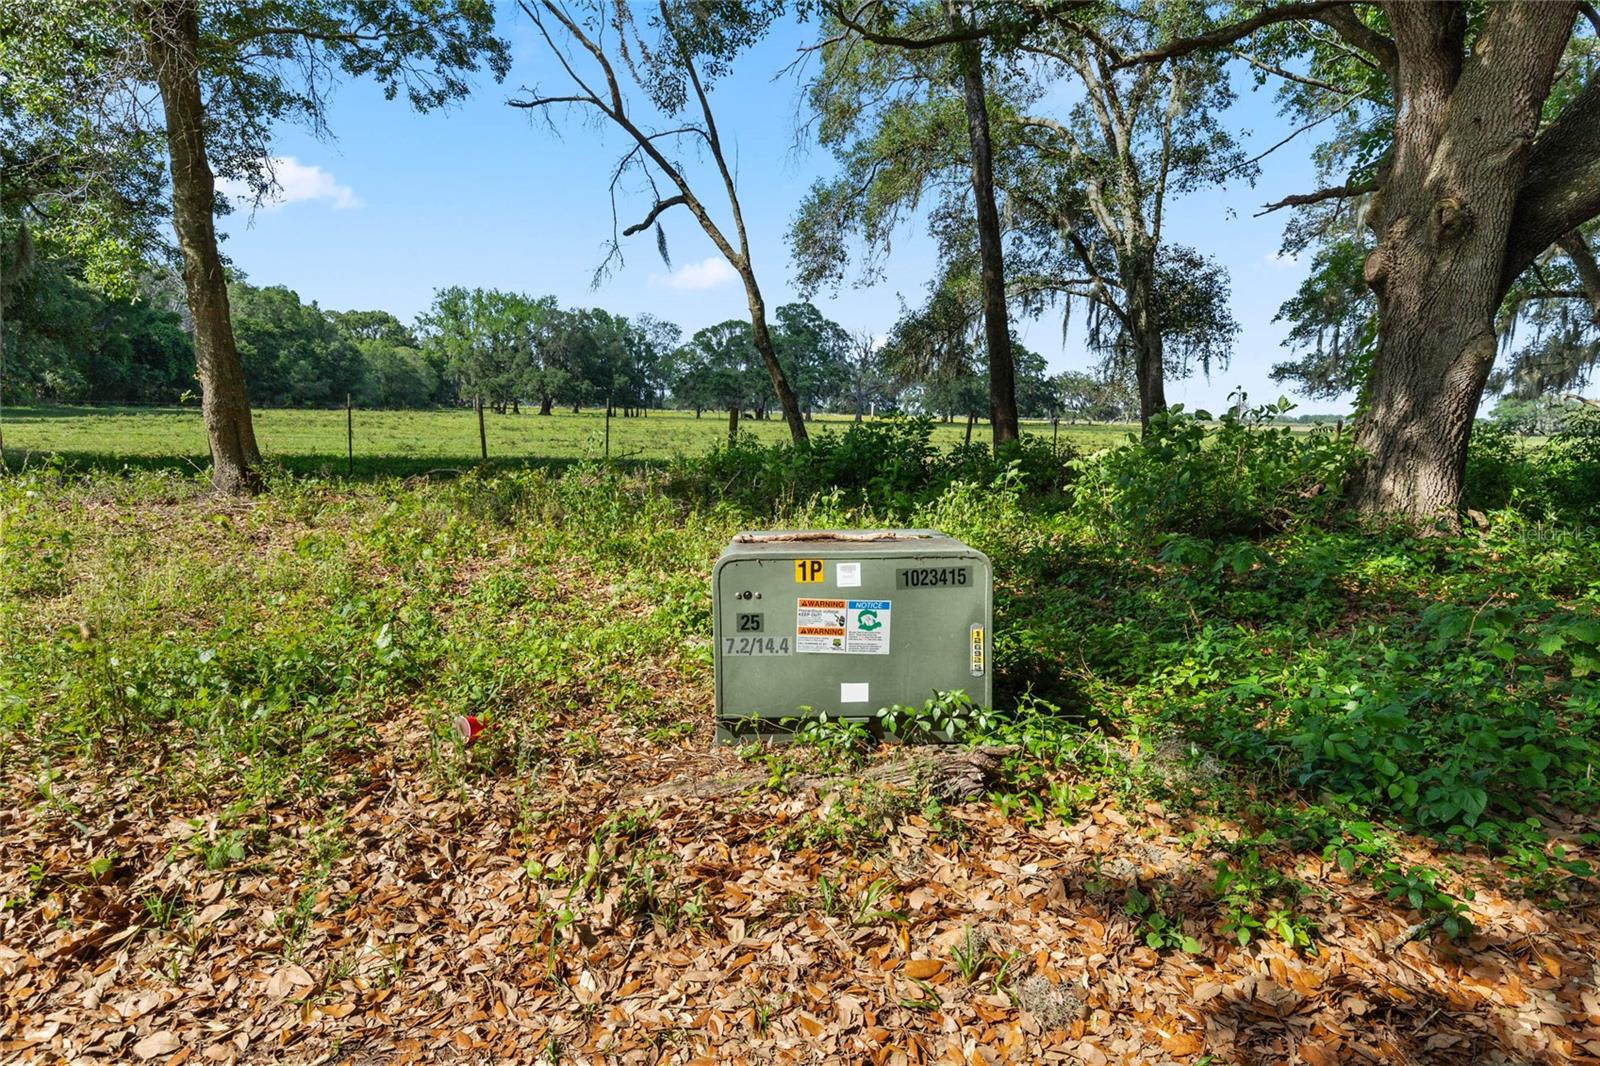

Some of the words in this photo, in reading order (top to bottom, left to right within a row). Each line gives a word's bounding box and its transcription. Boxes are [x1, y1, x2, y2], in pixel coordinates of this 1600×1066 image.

[798, 560, 822, 582] 1P
[902, 567, 967, 587] 1023415
[807, 600, 845, 609] WARNING
[741, 614, 760, 631] 25
[807, 627, 844, 636] WARNING
[725, 637, 789, 656] 7.2/14.4
